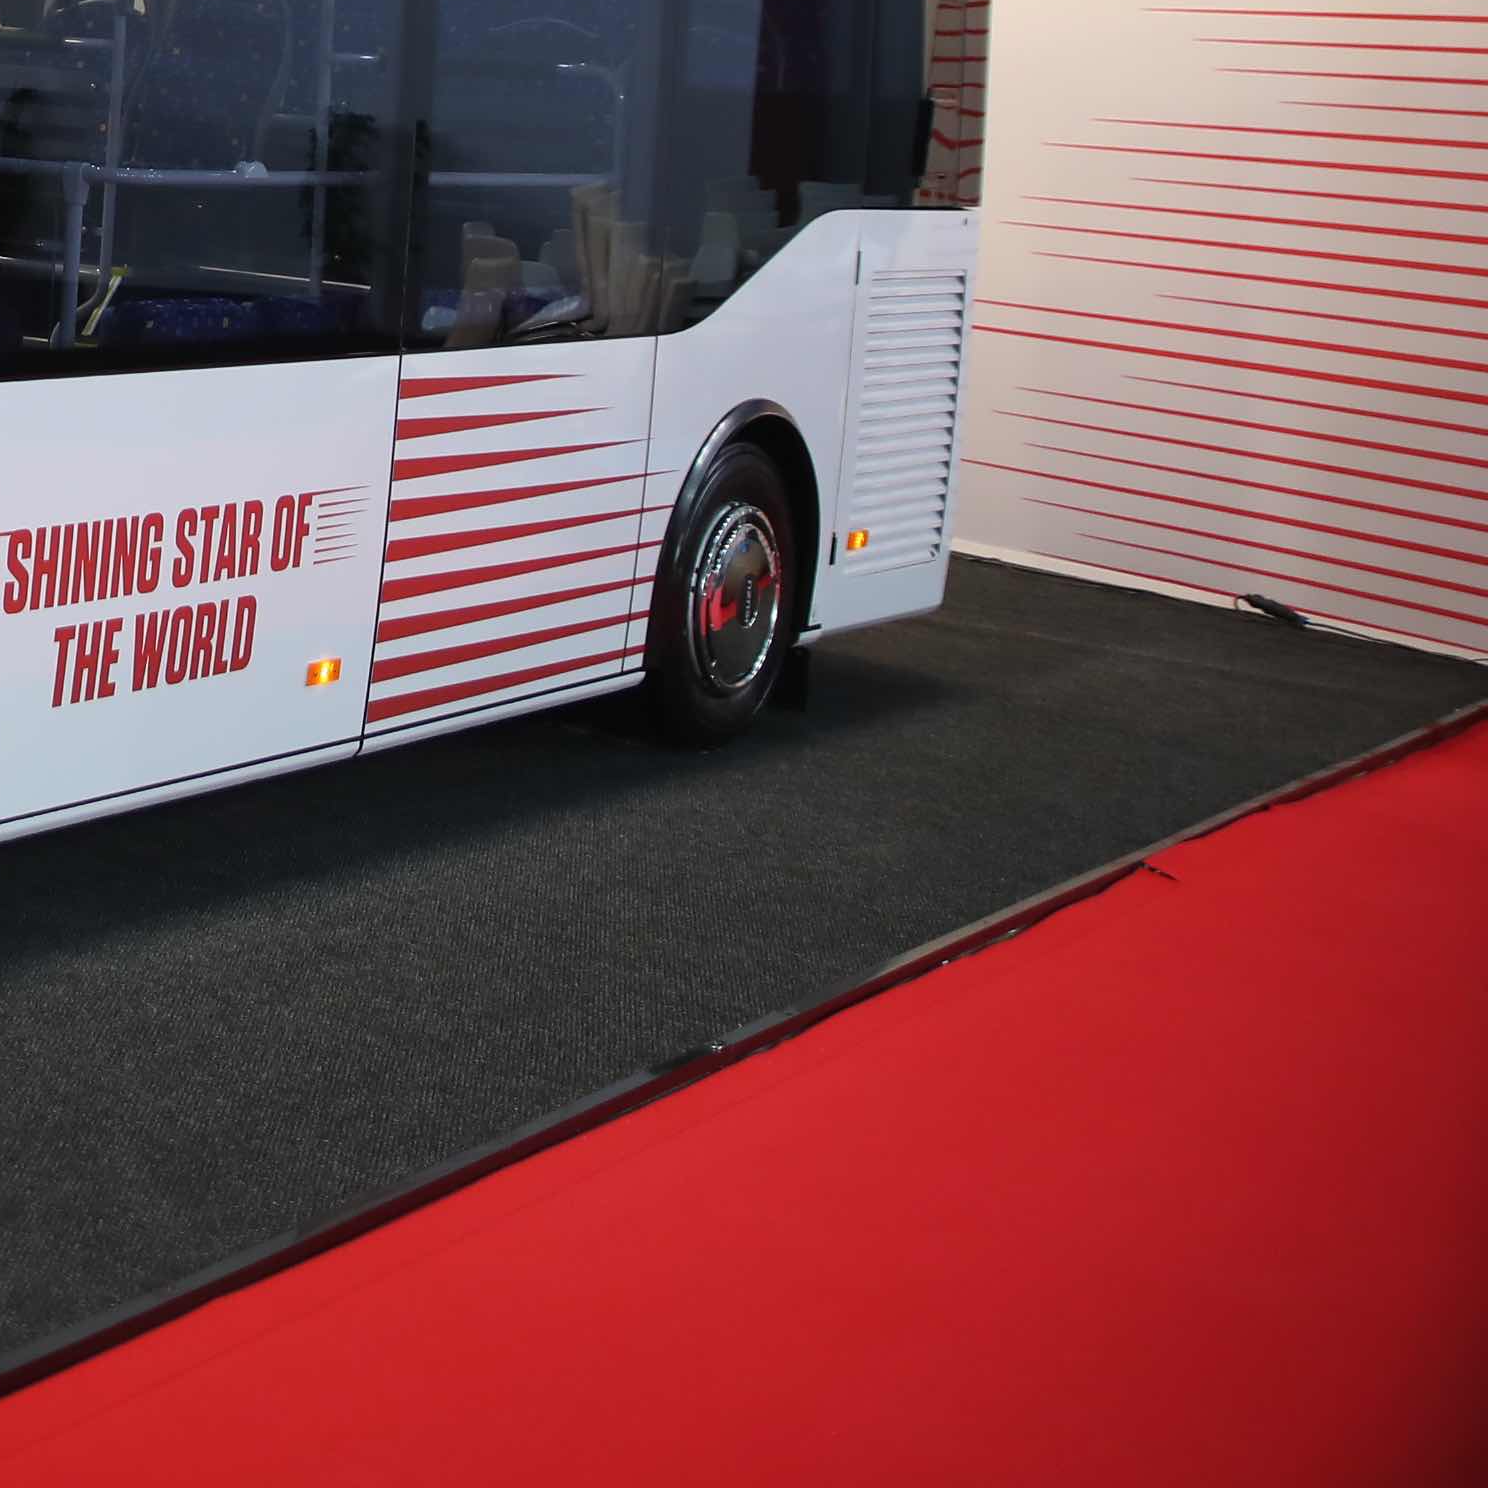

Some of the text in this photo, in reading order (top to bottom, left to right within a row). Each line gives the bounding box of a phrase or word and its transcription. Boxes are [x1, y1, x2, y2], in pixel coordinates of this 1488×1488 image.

[3, 493, 313, 614] SHINING STAR OF
[51, 595, 257, 708] THE WORLD
